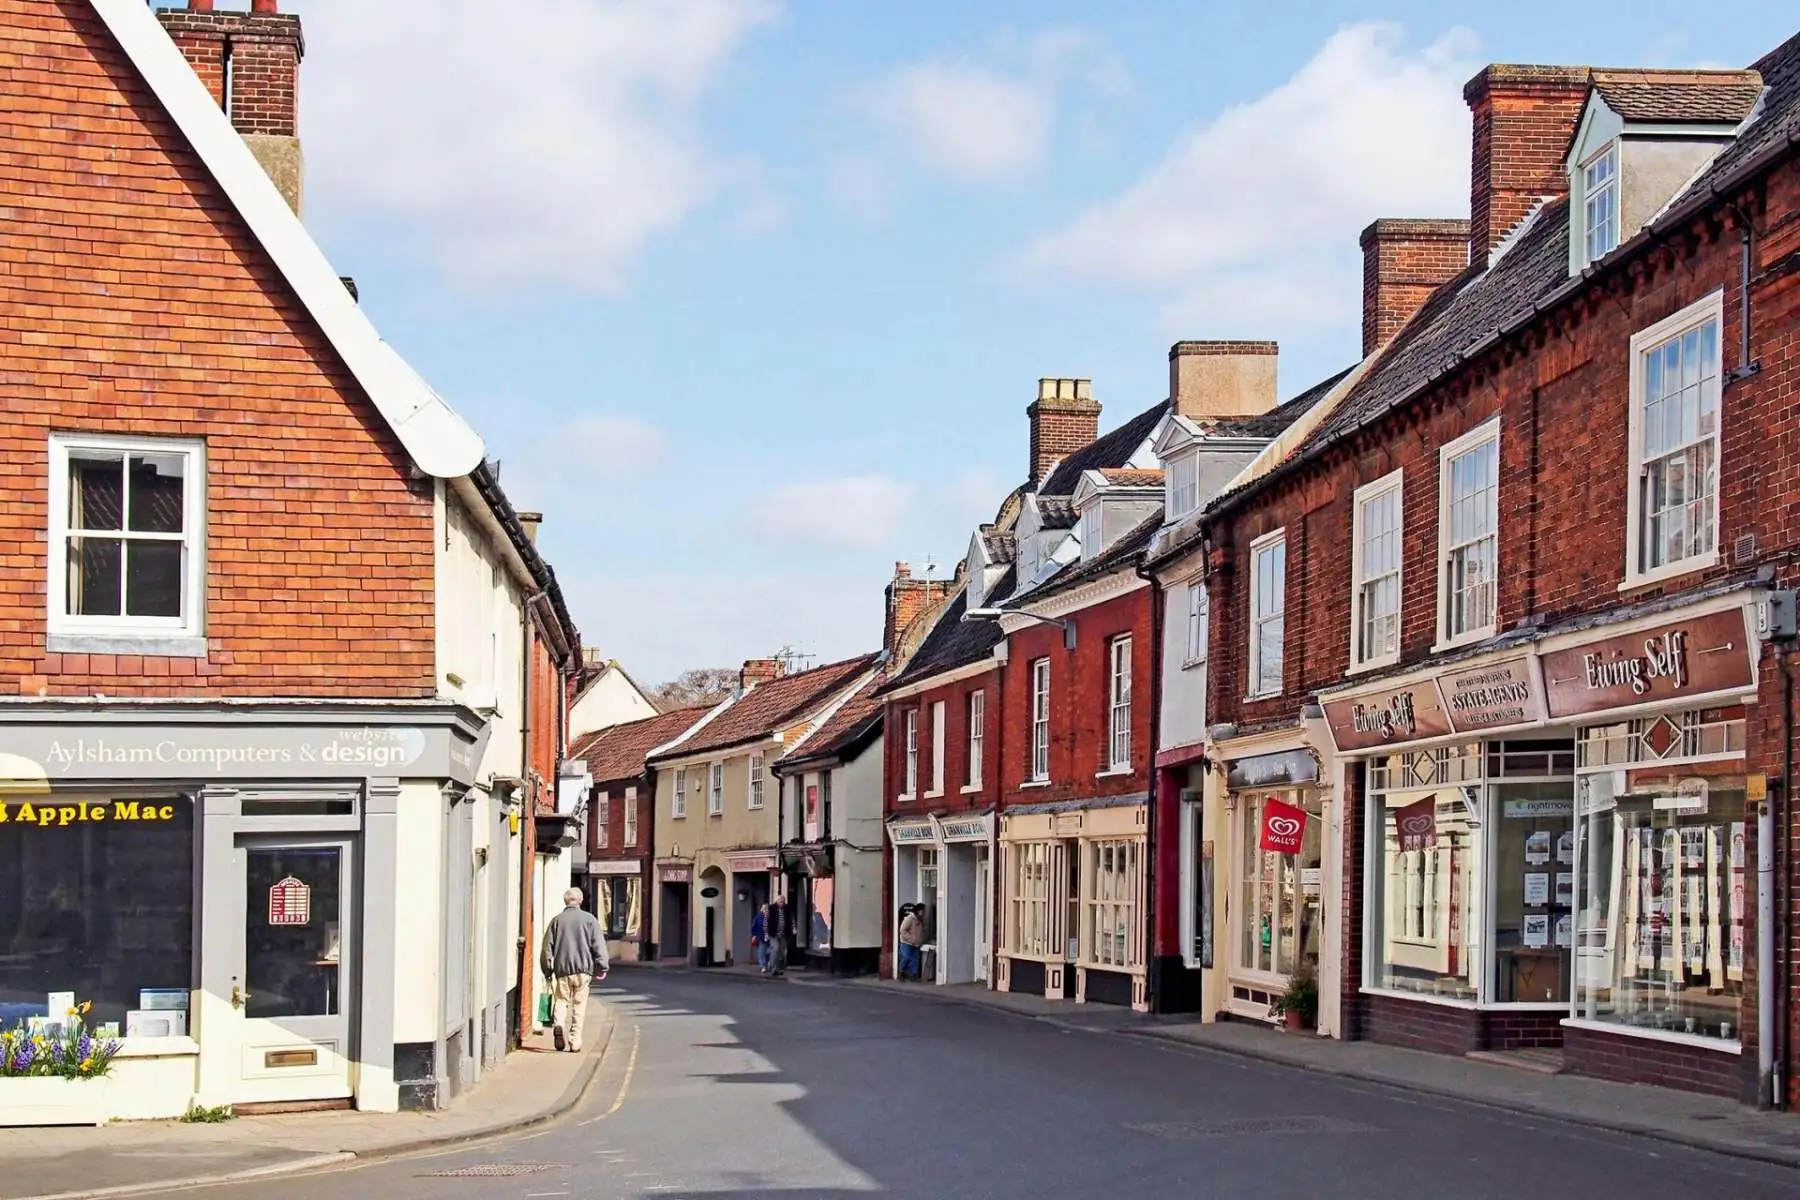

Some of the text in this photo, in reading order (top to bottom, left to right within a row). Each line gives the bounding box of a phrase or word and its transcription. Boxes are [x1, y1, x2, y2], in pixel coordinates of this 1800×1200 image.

[1583, 631, 1686, 695] Ewing Self
[1451, 681, 1529, 711] ESTATE AGENTS
[1352, 692, 1413, 739] Ewing Self
[299, 742, 317, 763] &
[321, 740, 406, 768] design
[15, 800, 175, 826] Apple Mac
[1266, 834, 1298, 846] WALL'S
